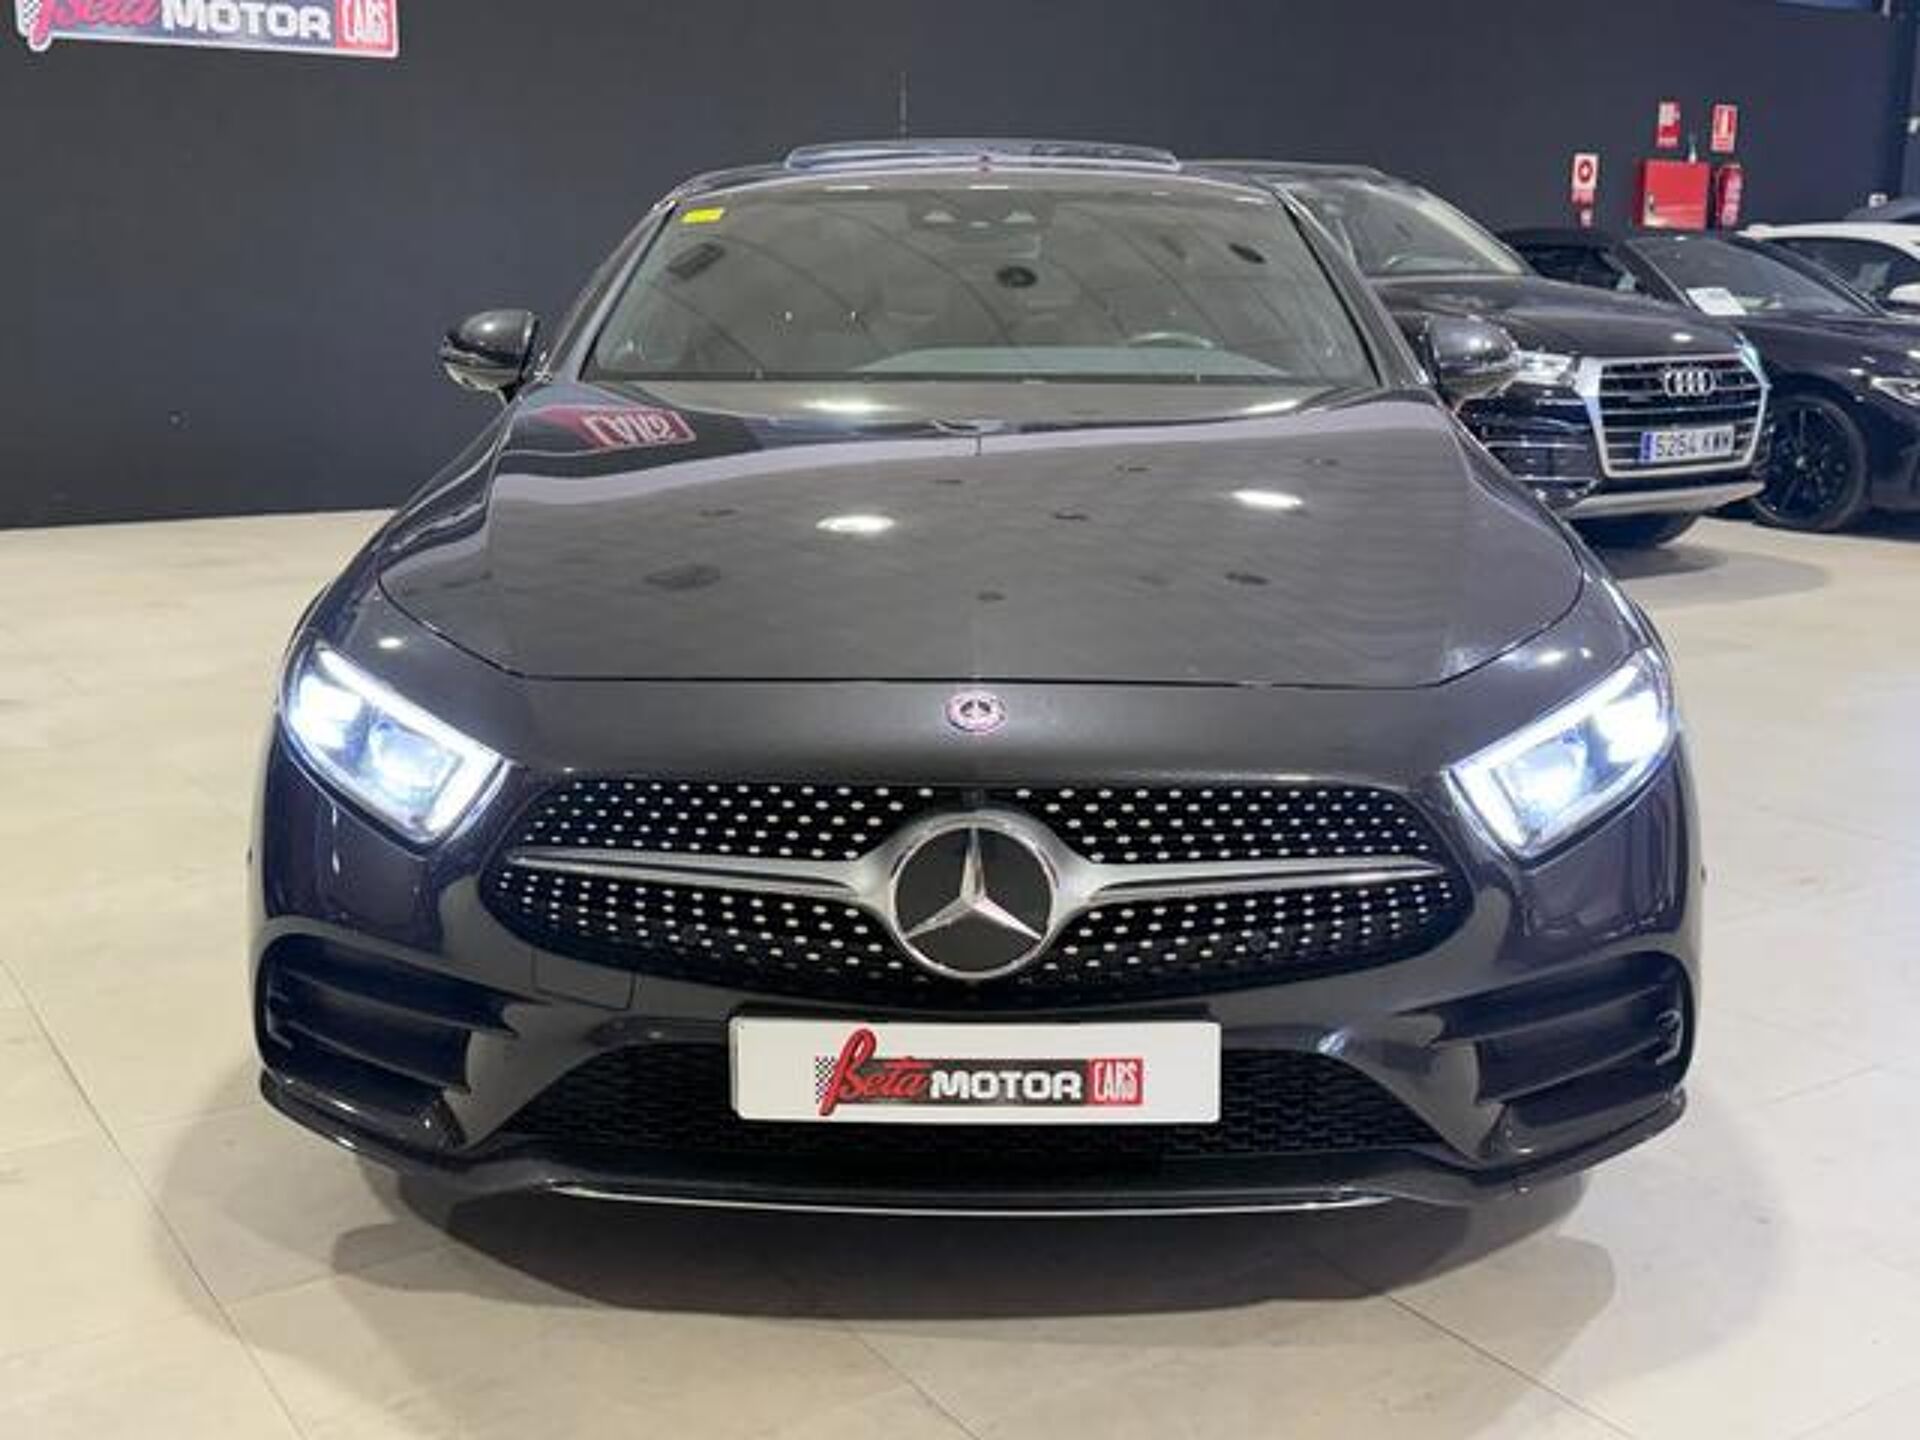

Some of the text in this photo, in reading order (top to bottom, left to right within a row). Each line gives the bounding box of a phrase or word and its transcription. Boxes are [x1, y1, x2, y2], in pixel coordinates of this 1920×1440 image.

[162, 0, 331, 40] MOTOR
[341, 0, 388, 43] CARS
[930, 1070, 1082, 1100] MOTOR
[1094, 1061, 1139, 1102] CARS
